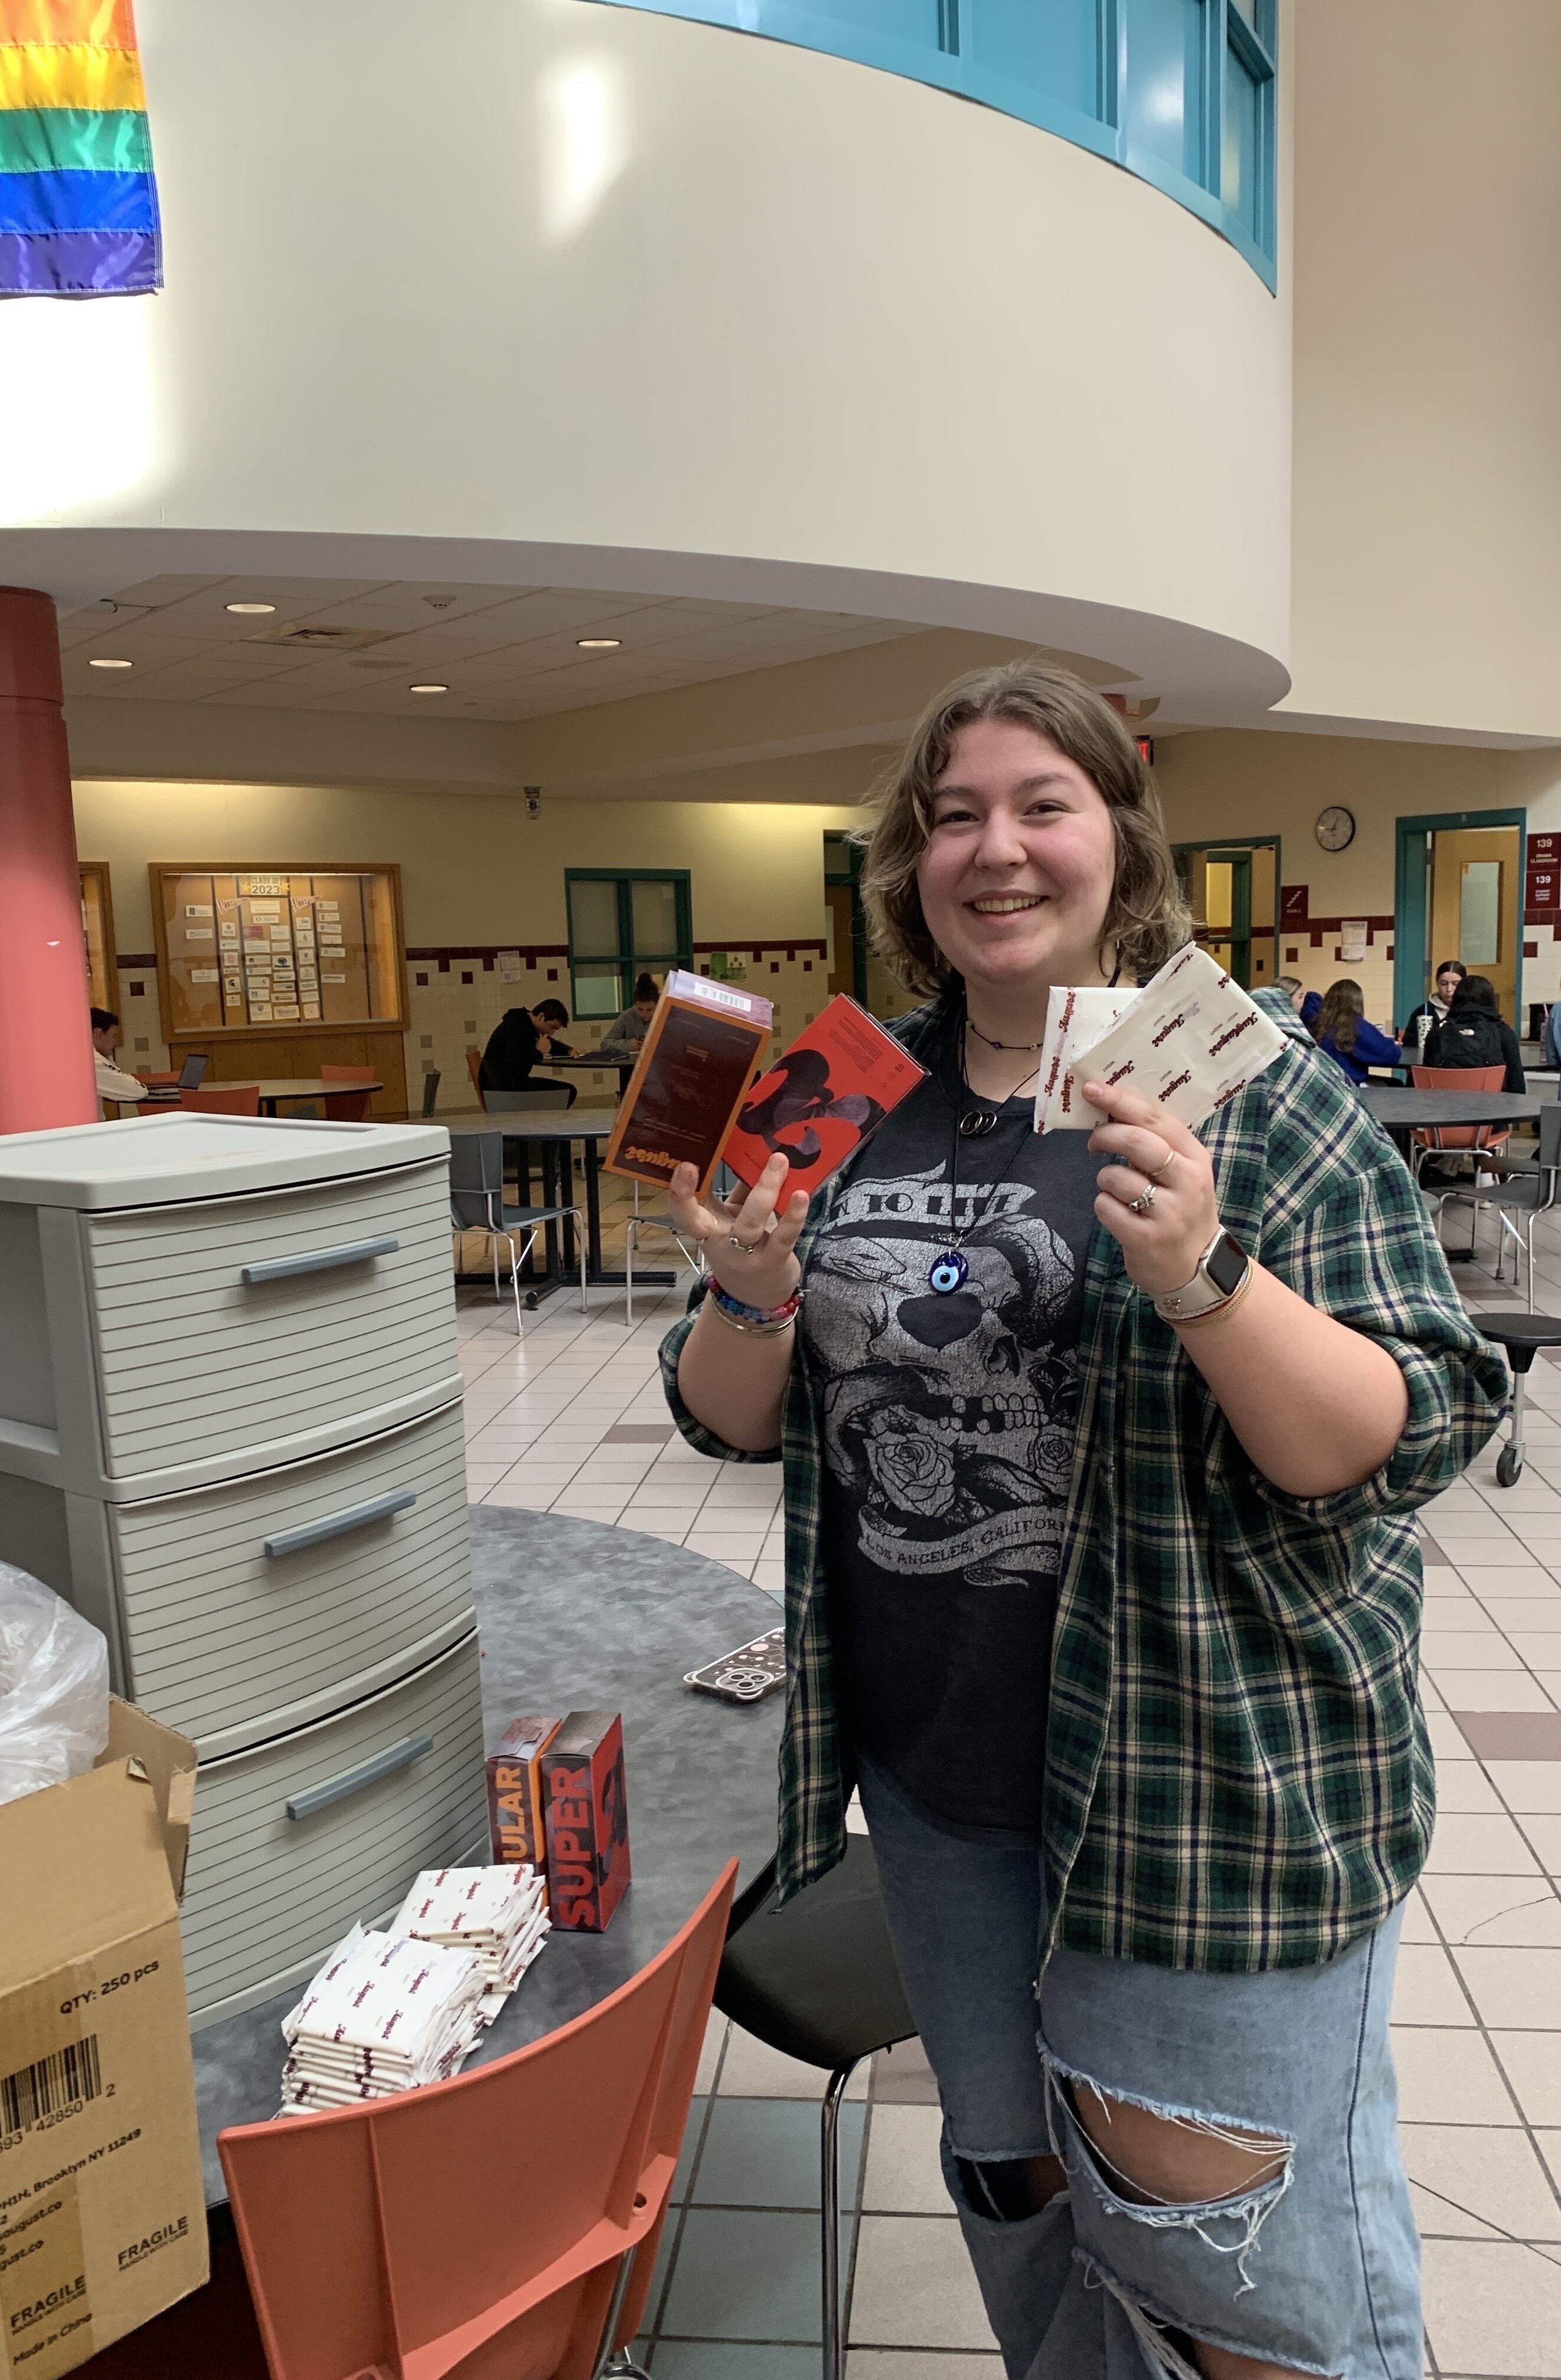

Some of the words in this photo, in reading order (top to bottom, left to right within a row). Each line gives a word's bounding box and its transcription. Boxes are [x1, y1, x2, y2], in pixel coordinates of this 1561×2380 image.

[1536, 838, 1552, 848] 139
[252, 885, 280, 894] 2023
[1536, 875, 1551, 884] 139
[1152, 1014, 1185, 1047] August
[1158, 1069, 1191, 1102] August
[864, 1534, 892, 1560] LOS
[495, 1767, 527, 1864] ULAR
[550, 1766, 595, 1926] SUPER
[60, 1989, 97, 2015] QTY:
[101, 1973, 130, 1995] 250
[133, 1960, 159, 1982] pcs
[36, 2100, 83, 2132] 42850
[106, 2083, 116, 2098] 2
[33, 2159, 86, 2193] Brooklyn
[88, 2146, 105, 2163] NY
[108, 2128, 141, 2153] 11249
[0, 2240, 44, 2272] gust.co
[118, 2216, 188, 2265] FRAGILE
[10, 2274, 85, 2328] FRAGILE
[14, 2342, 45, 2366] Made
[47, 2333, 57, 2346] in
[60, 2312, 93, 2337] China
